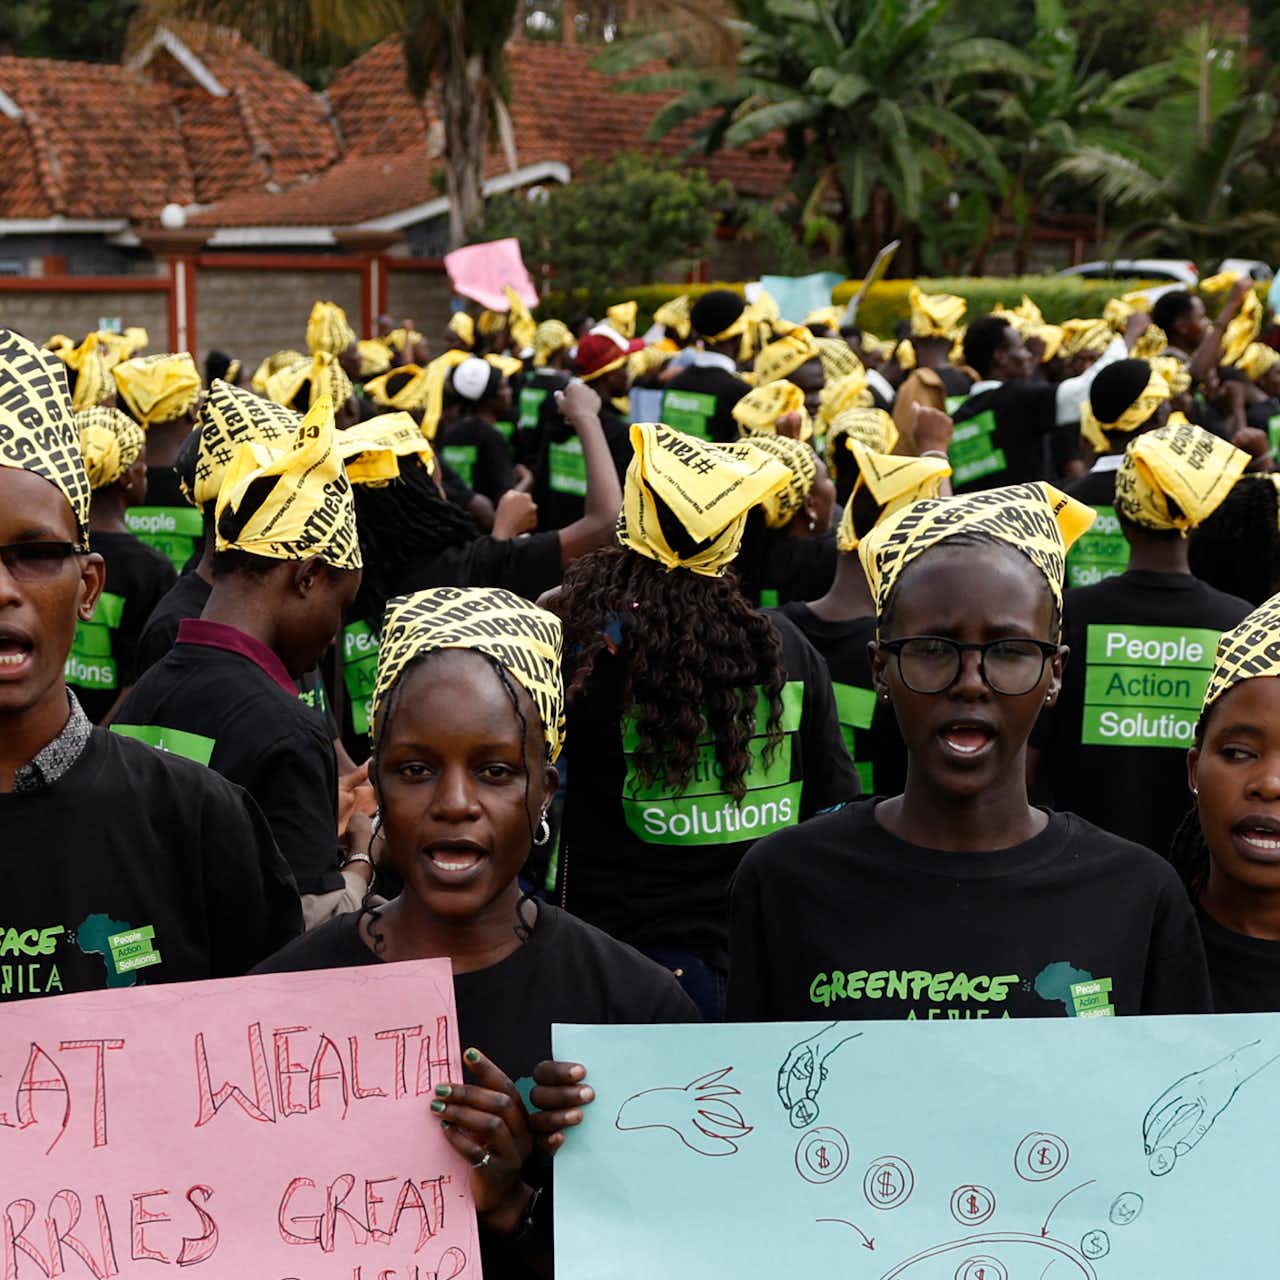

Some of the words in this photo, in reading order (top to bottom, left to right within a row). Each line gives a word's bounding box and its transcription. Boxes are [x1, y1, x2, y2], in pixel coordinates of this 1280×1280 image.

[1106, 633, 1204, 667] People
[1105, 673, 1191, 699] Action
[1098, 711, 1199, 740] Solutio
[643, 797, 792, 836] Solutions
[810, 969, 1019, 1007] GREENPEACE
[193, 1015, 455, 1129] WEALTH
[278, 1173, 453, 1254] GREAT
